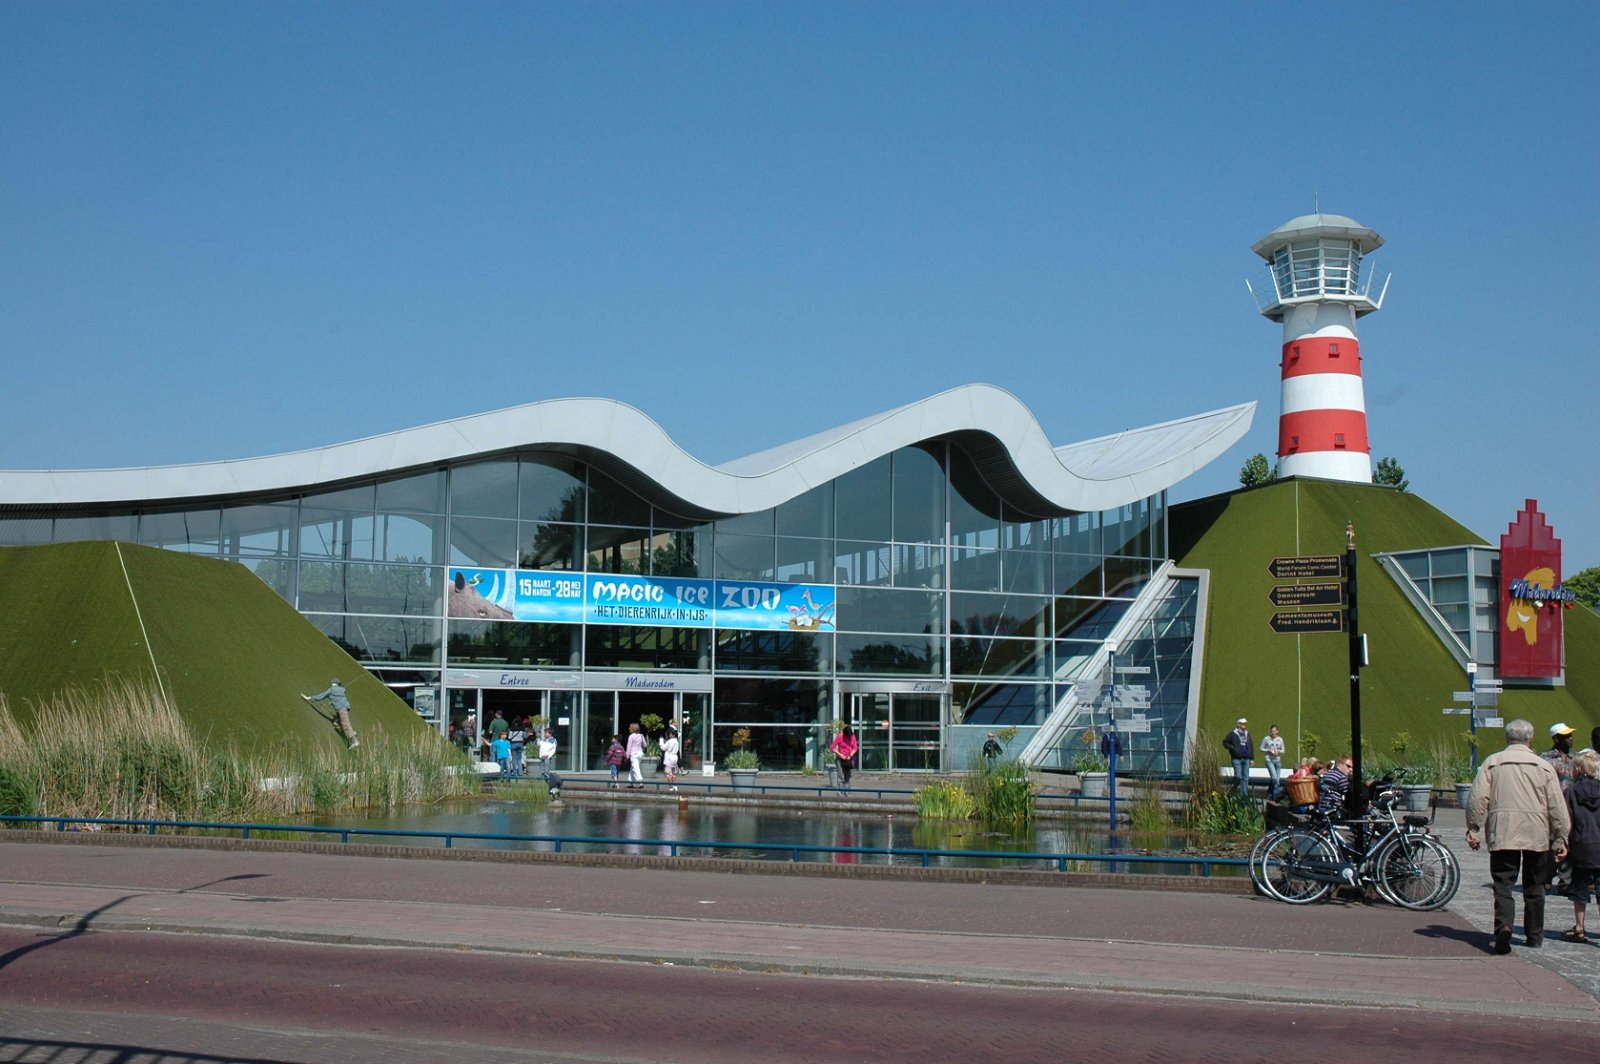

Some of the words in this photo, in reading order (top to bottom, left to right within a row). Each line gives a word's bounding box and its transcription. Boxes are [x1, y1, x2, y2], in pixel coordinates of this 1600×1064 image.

[519, 579, 532, 596] 15
[555, 580, 570, 598] 28
[592, 581, 665, 602] MAGIC
[722, 586, 781, 610] ZOO
[1509, 579, 1576, 601] Madurodam
[500, 674, 530, 686] Entree
[625, 676, 676, 689] Madurodam
[913, 682, 931, 691] Exit
